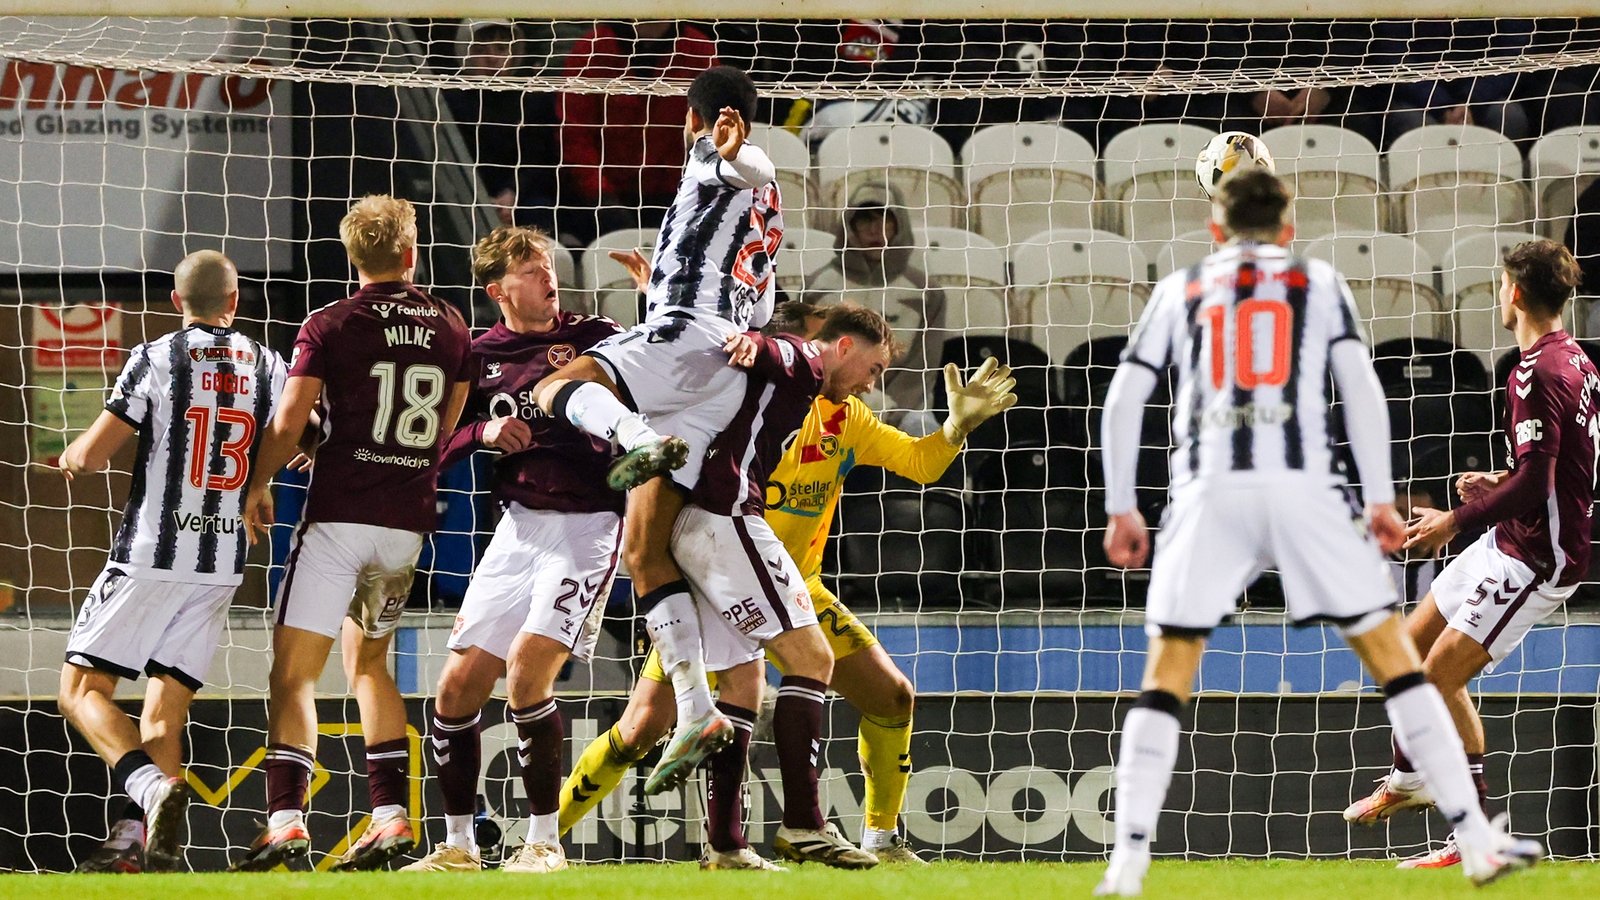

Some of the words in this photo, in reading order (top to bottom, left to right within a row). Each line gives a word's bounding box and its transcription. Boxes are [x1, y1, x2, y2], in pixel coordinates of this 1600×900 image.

[35, 114, 140, 139] Glazing
[152, 114, 273, 139] Systems
[397, 305, 439, 318] FanHub
[384, 325, 436, 349] MILNE
[1196, 298, 1294, 392] 10
[370, 361, 446, 449] 18
[184, 406, 256, 491] 13
[789, 480, 832, 496] Stellar
[173, 511, 235, 534] Vertu
[553, 578, 580, 615] 2
[1466, 577, 1498, 606] 5
